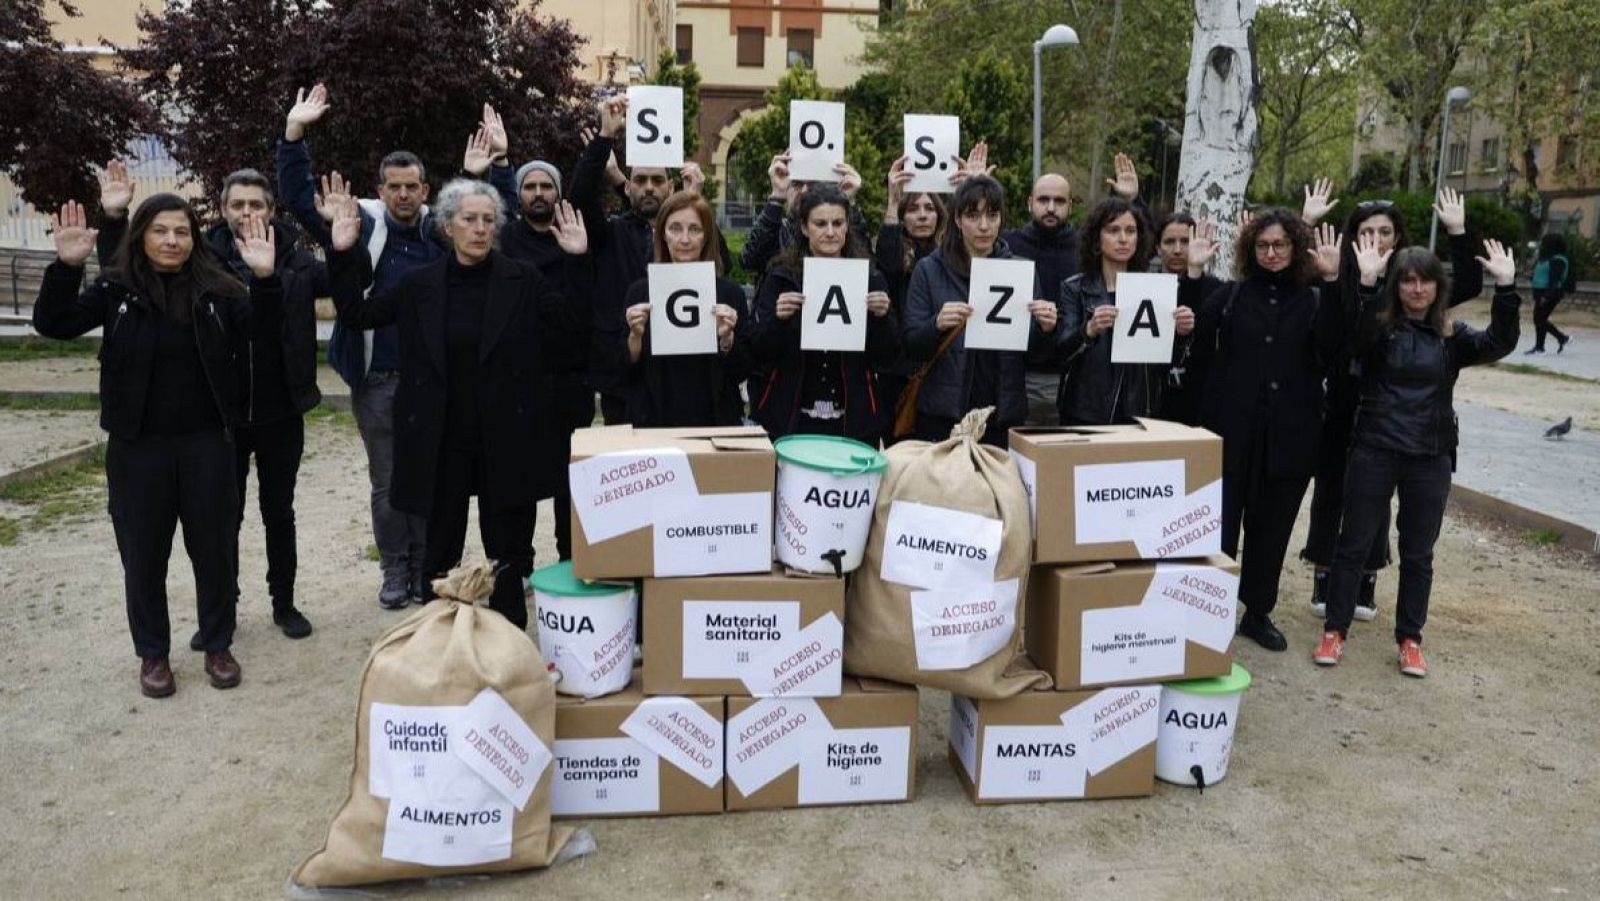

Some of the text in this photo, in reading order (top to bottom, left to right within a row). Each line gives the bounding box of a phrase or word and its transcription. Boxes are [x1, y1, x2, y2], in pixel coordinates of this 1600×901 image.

[636, 108, 672, 145] S.
[799, 120, 835, 150] O.
[914, 136, 948, 171] S.
[665, 289, 700, 328] G
[816, 285, 852, 325] A
[985, 285, 1014, 325] Z
[1127, 300, 1161, 338] A
[600, 457, 657, 485] ACCESO
[594, 470, 675, 506] DENEGADO
[804, 486, 870, 508] AGUA
[1087, 485, 1173, 503] MEDICINAS
[666, 523, 759, 539] COMBUSTIBLE
[1162, 504, 1211, 537] ACCESO
[896, 534, 987, 561] ALIMENTOS
[1180, 574, 1228, 600] ACCESO
[941, 600, 997, 619] ACCESO
[1162, 586, 1229, 619] DENEGADO
[538, 606, 595, 634] AGUA
[706, 613, 777, 628] Material
[931, 615, 1005, 637] DENEGADO
[705, 628, 781, 641] sanitario
[1091, 643, 1127, 653] higiene
[1114, 631, 1146, 641] Kits de
[772, 648, 841, 699] DENEGADO
[773, 641, 821, 678] ACCESO
[1094, 689, 1140, 723] ACCESO
[1165, 709, 1227, 730] AGUA
[668, 711, 716, 749] ACCESO
[736, 713, 807, 763] DENEGADO
[738, 706, 787, 743] ACCESO
[389, 736, 447, 752] infantil
[488, 723, 529, 765] ACCESO
[647, 715, 713, 770] DENEGADO
[828, 741, 878, 756] Kits de
[997, 743, 1076, 758] MANTAS
[464, 728, 524, 789] DENEGADO
[556, 755, 641, 769] Tiendas de
[827, 755, 882, 770] higiene
[400, 806, 502, 826] ALIMENTOS
